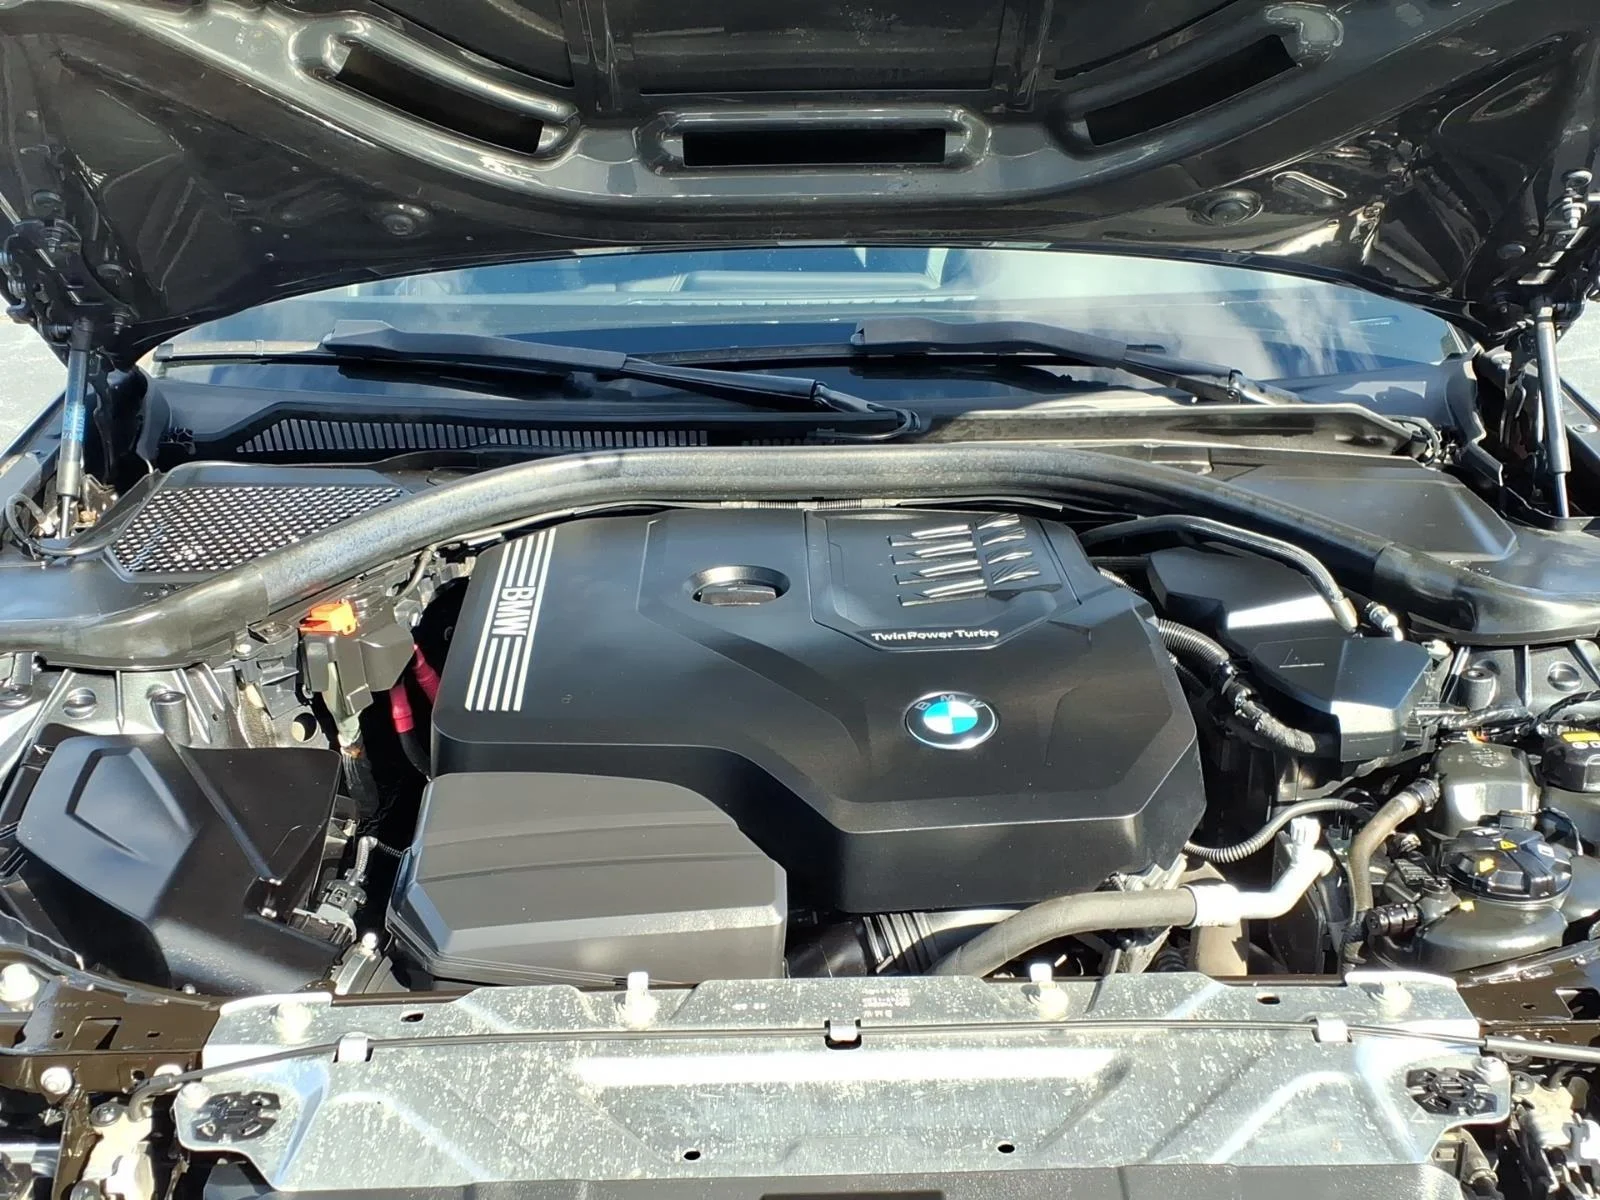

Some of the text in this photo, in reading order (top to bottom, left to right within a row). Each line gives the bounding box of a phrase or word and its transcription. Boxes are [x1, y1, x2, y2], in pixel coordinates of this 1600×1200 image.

[491, 587, 536, 636] BMW
[871, 629, 999, 640] TwinPower Turbo
[914, 694, 984, 711] BMW
